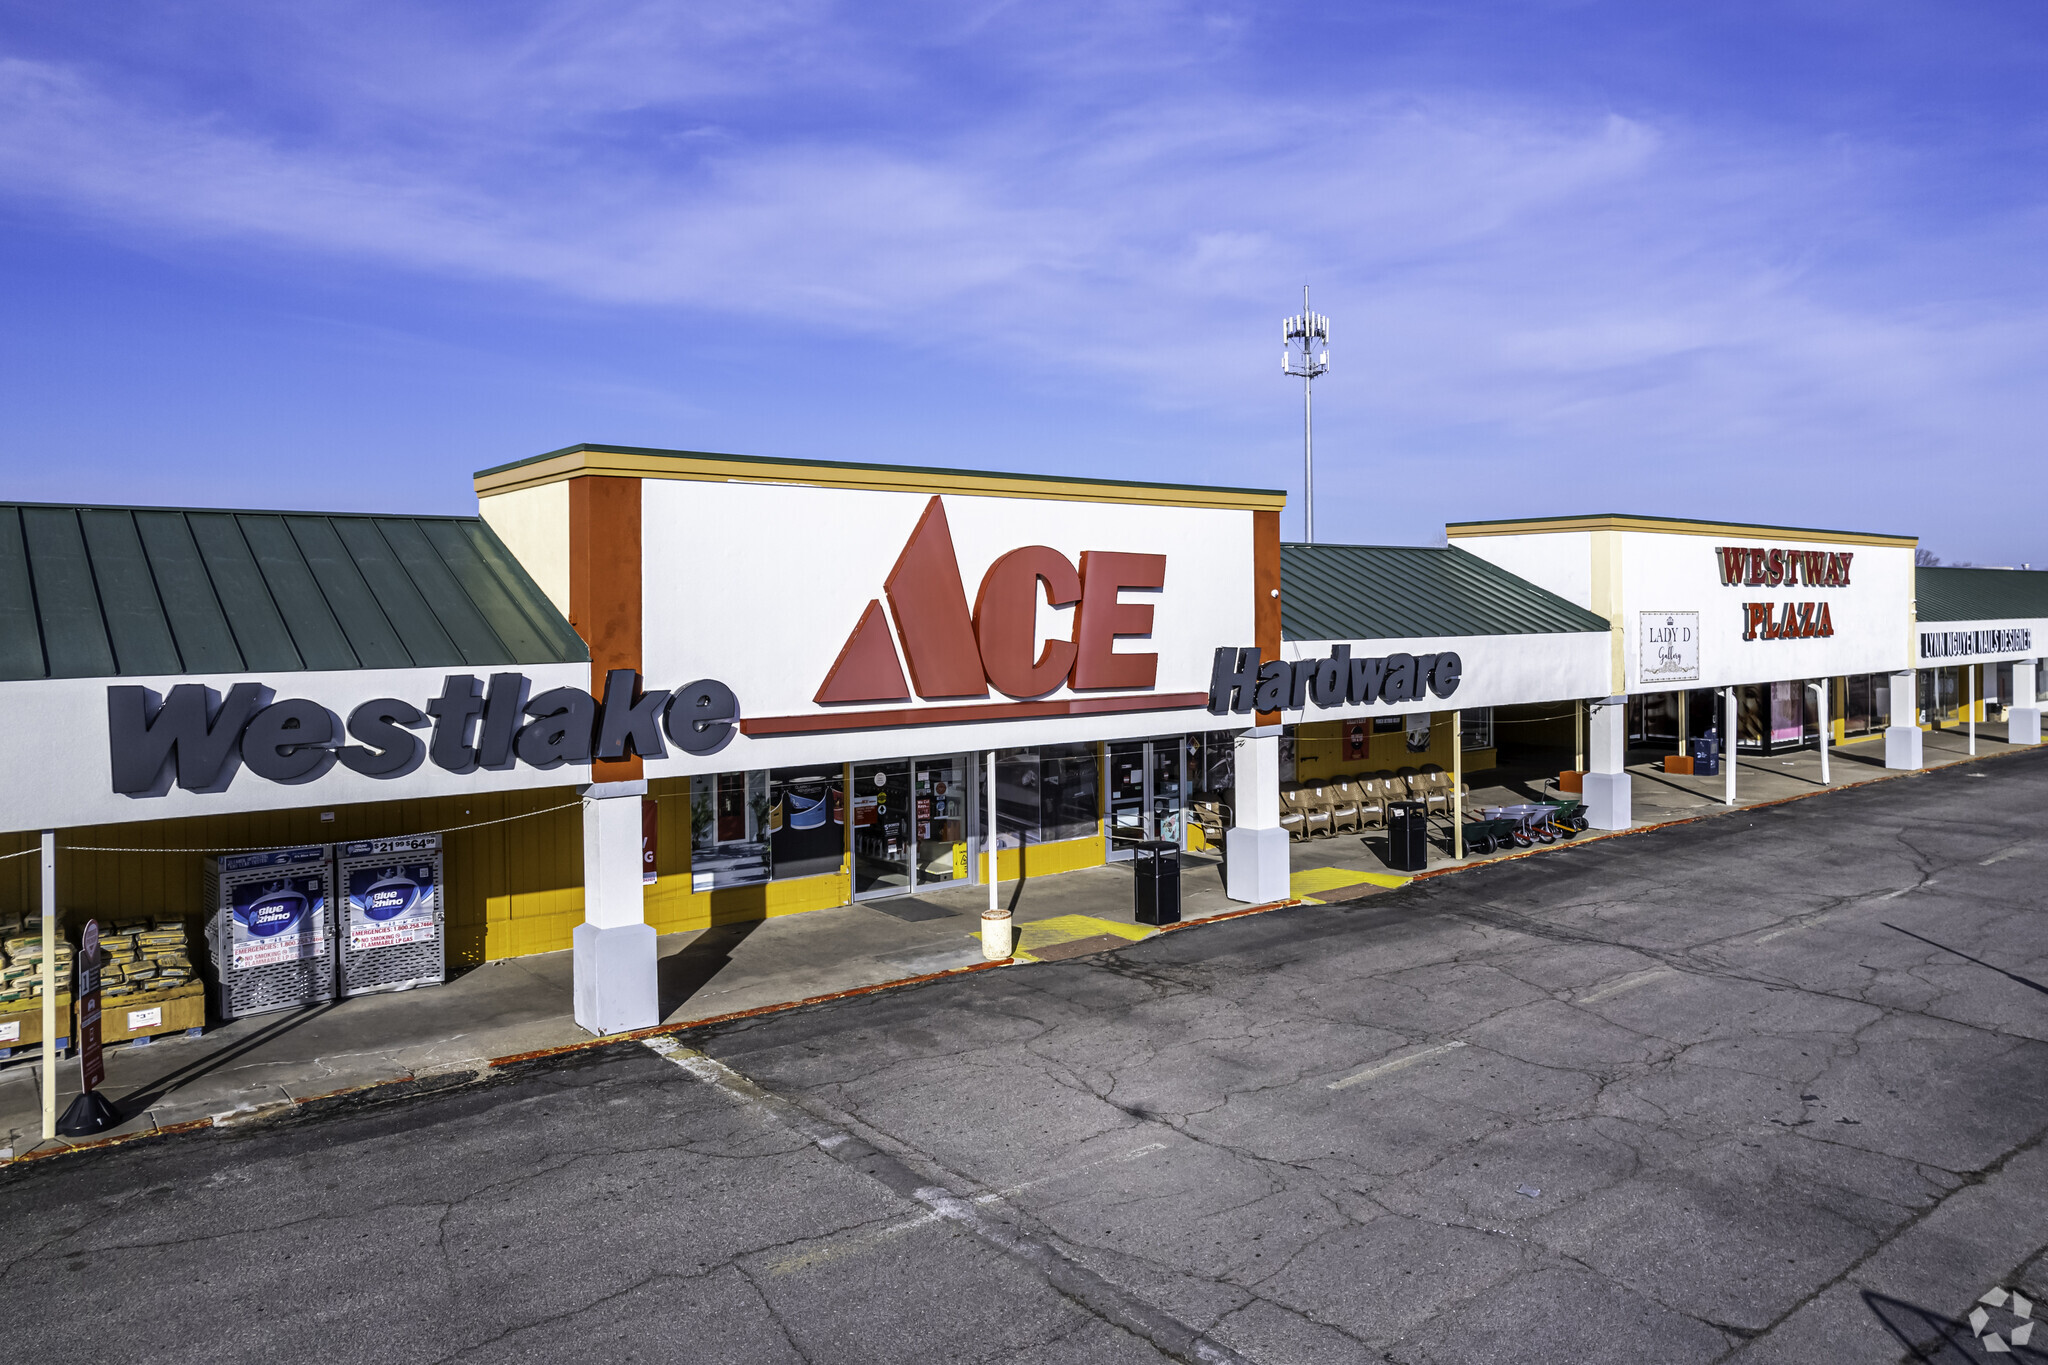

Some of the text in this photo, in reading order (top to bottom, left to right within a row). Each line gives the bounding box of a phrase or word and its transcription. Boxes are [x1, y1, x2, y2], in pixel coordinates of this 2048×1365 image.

[1715, 547, 1854, 587] WESTWAY
[812, 494, 1166, 704] ACE
[1742, 602, 1834, 641] PLAZA
[1650, 627, 1691, 642] LADY D
[1925, 628, 2031, 658] LYNN NGUYEN NAILS DESIGNER
[1658, 645, 1682, 665] Gallery
[1207, 644, 1462, 716] Hardware
[107, 669, 740, 798] Westlake
[373, 891, 397, 900] Blue
[258, 905, 284, 916] Blue
[352, 927, 391, 936] EMERGENCIES:
[370, 933, 394, 942] SMOKING
[234, 943, 279, 956] EMERGENCIES:
[361, 938, 394, 949] FLAMMABLE
[244, 956, 281, 967] FLAMMABLE
[254, 950, 281, 959] SMOKING
